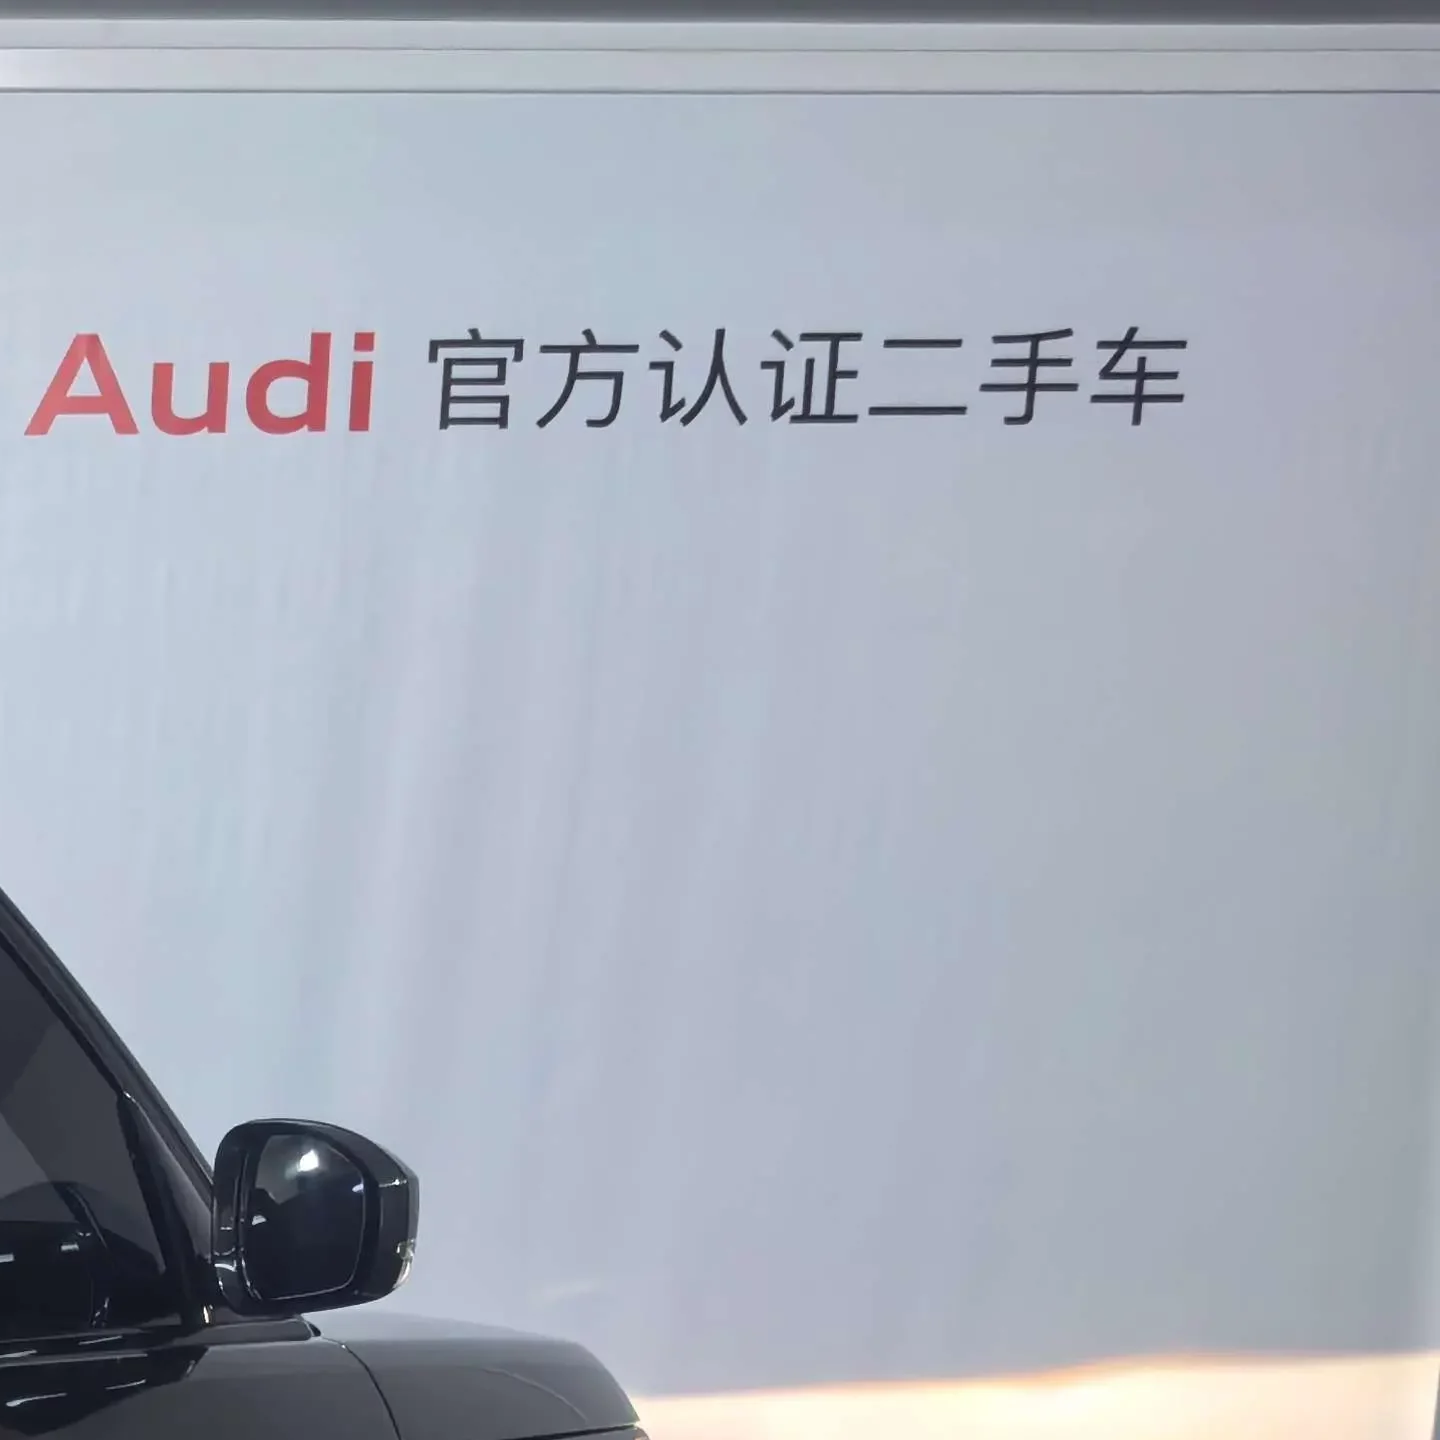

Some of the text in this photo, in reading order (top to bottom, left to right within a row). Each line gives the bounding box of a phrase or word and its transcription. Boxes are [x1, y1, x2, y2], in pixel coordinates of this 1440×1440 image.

[26, 326, 1189, 436] Audi 官方认证二手车
